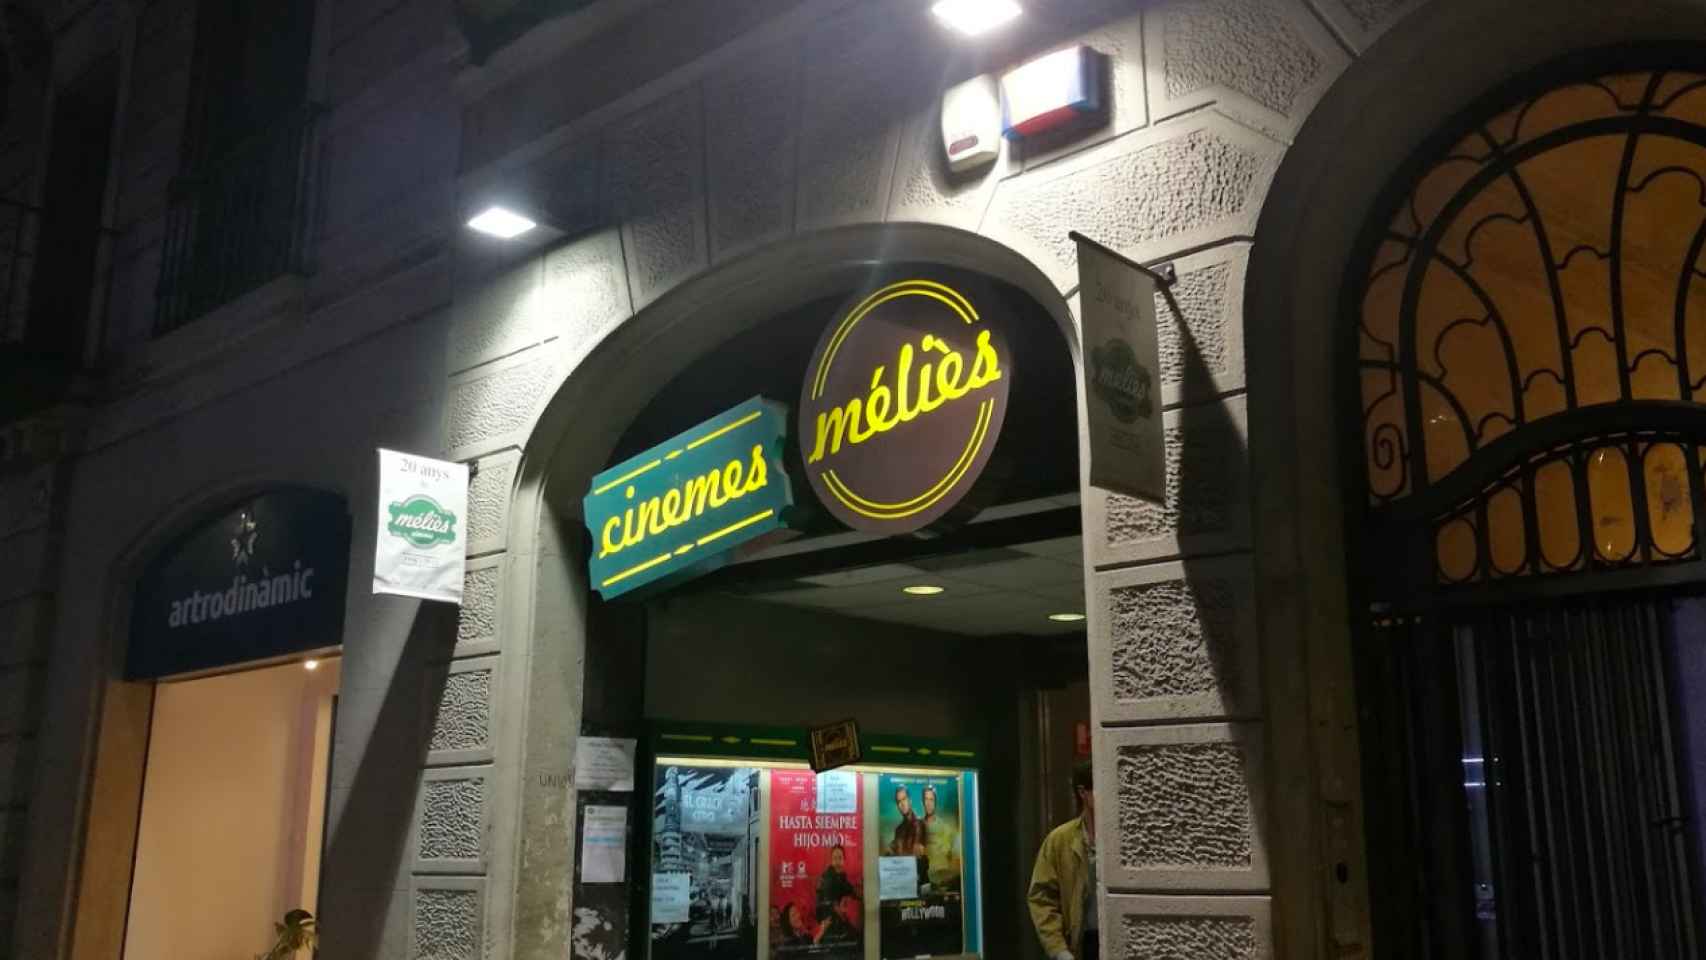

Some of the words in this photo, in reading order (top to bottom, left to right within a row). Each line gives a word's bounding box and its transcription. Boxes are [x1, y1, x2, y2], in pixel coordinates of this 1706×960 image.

[807, 329, 1002, 464] méliès
[400, 458, 416, 473] 20
[419, 464, 449, 481] anys
[600, 445, 767, 557] cinemes
[168, 560, 313, 628] artrodinàmic
[779, 815, 813, 830] HASTA
[815, 815, 858, 830] SIEMPRE
[793, 832, 820, 849] HIJO
